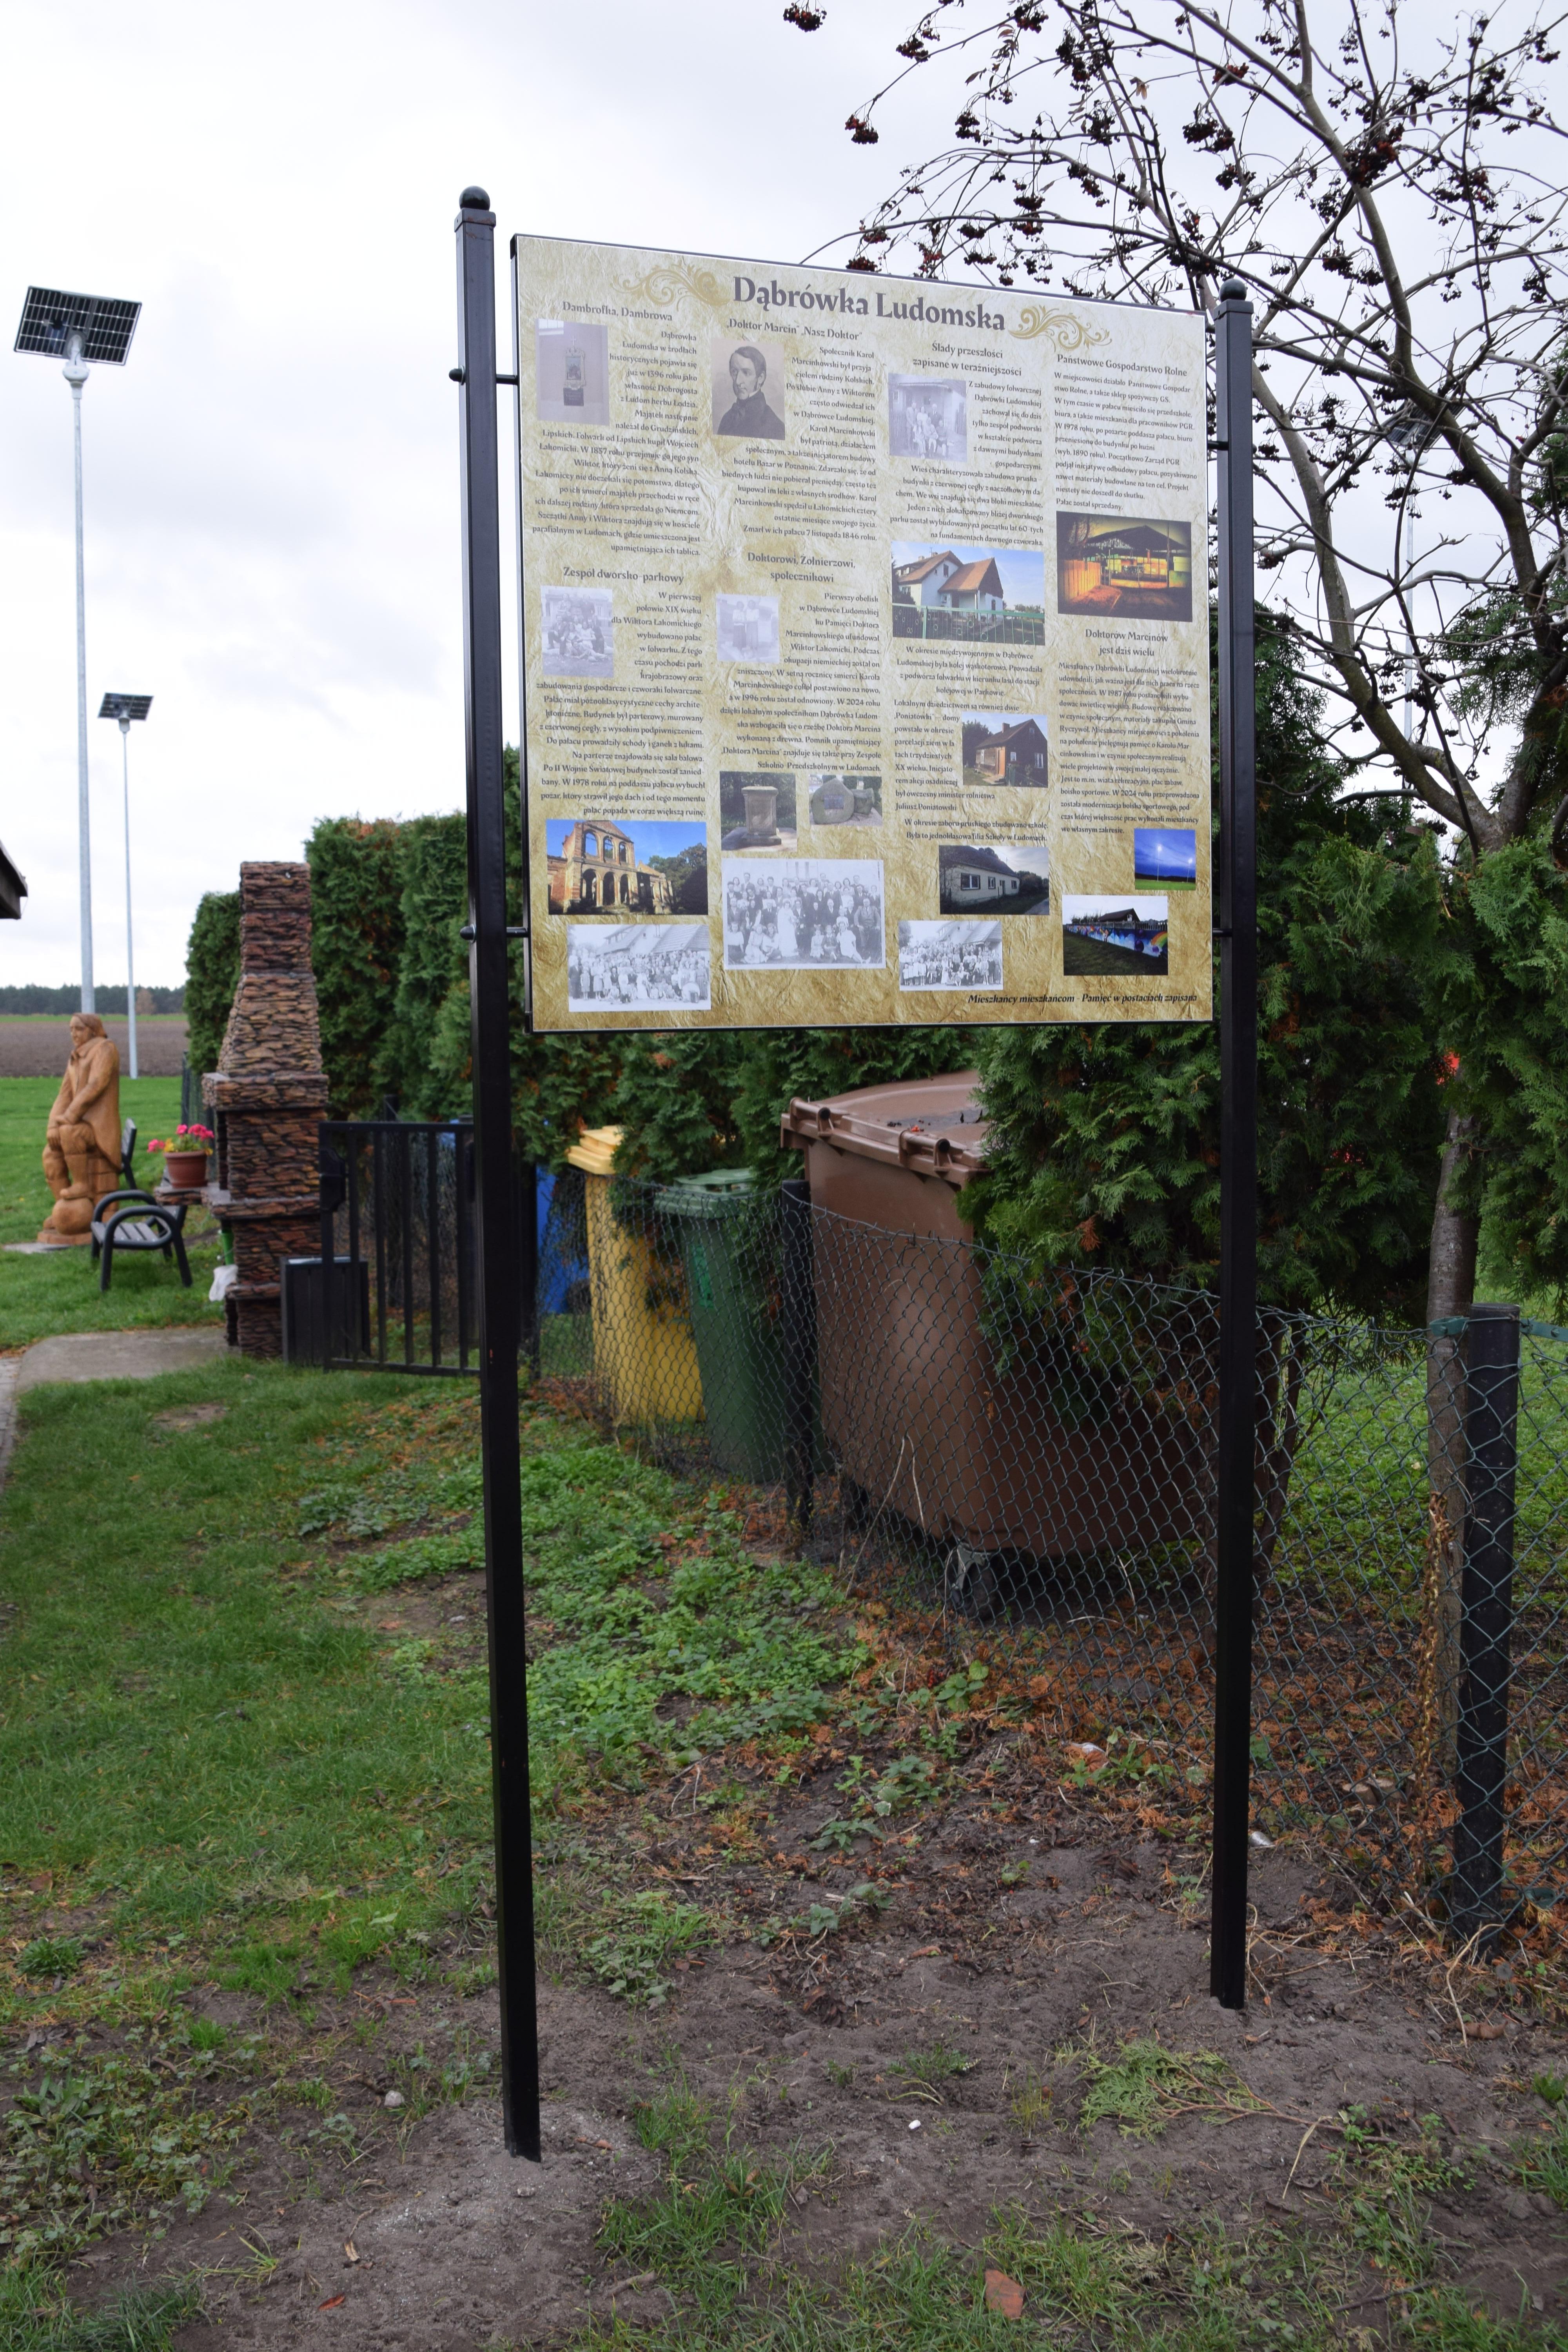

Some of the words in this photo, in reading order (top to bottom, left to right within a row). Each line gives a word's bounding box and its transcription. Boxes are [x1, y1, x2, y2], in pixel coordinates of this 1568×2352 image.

[733, 276, 869, 315] Dąbrówka
[876, 292, 1005, 330] Ludomska
[621, 307, 672, 321] Dambrowa
[610, 353, 658, 365] historycznych
[660, 359, 686, 367] pojawia
[913, 358, 949, 368] zapisane
[1105, 359, 1163, 374] Gospodarstwo
[1165, 366, 1187, 376] Rolne
[682, 373, 697, 382] jako
[974, 381, 1005, 392] zabudowy
[1006, 384, 1041, 396] folwarcznej
[1111, 390, 1127, 400] sklep
[1006, 397, 1042, 408] Ludomskiej
[1094, 415, 1127, 423] mieszkania
[829, 426, 875, 437] Marcinkowski
[576, 432, 604, 441] Folwark
[616, 435, 646, 445] Lipskich
[666, 439, 699, 448] Wojciech
[734, 457, 755, 466] hotelu
[757, 459, 776, 467] Bazar
[568, 513, 588, 523] Anny
[593, 515, 622, 524] Wiktora
[831, 519, 858, 528] swojego
[811, 529, 841, 539] listopada
[939, 531, 984, 541] fundamentach
[984, 535, 1012, 545] dawnego
[668, 593, 701, 603] pierwszej
[824, 592, 854, 603] Pierwszy
[637, 632, 683, 640] wybudowano
[1098, 645, 1114, 656] jest
[1132, 647, 1154, 656] wielu
[1002, 676, 1014, 684] lasu
[1024, 679, 1040, 687] stacji
[1068, 738, 1097, 746] pokolenie
[910, 752, 952, 760] trzydziestych
[618, 780, 651, 789] poddaszu
[1120, 789, 1137, 797] 2024
[1121, 993, 1163, 1004] postaciach
[1164, 993, 1197, 1004] zapisana
